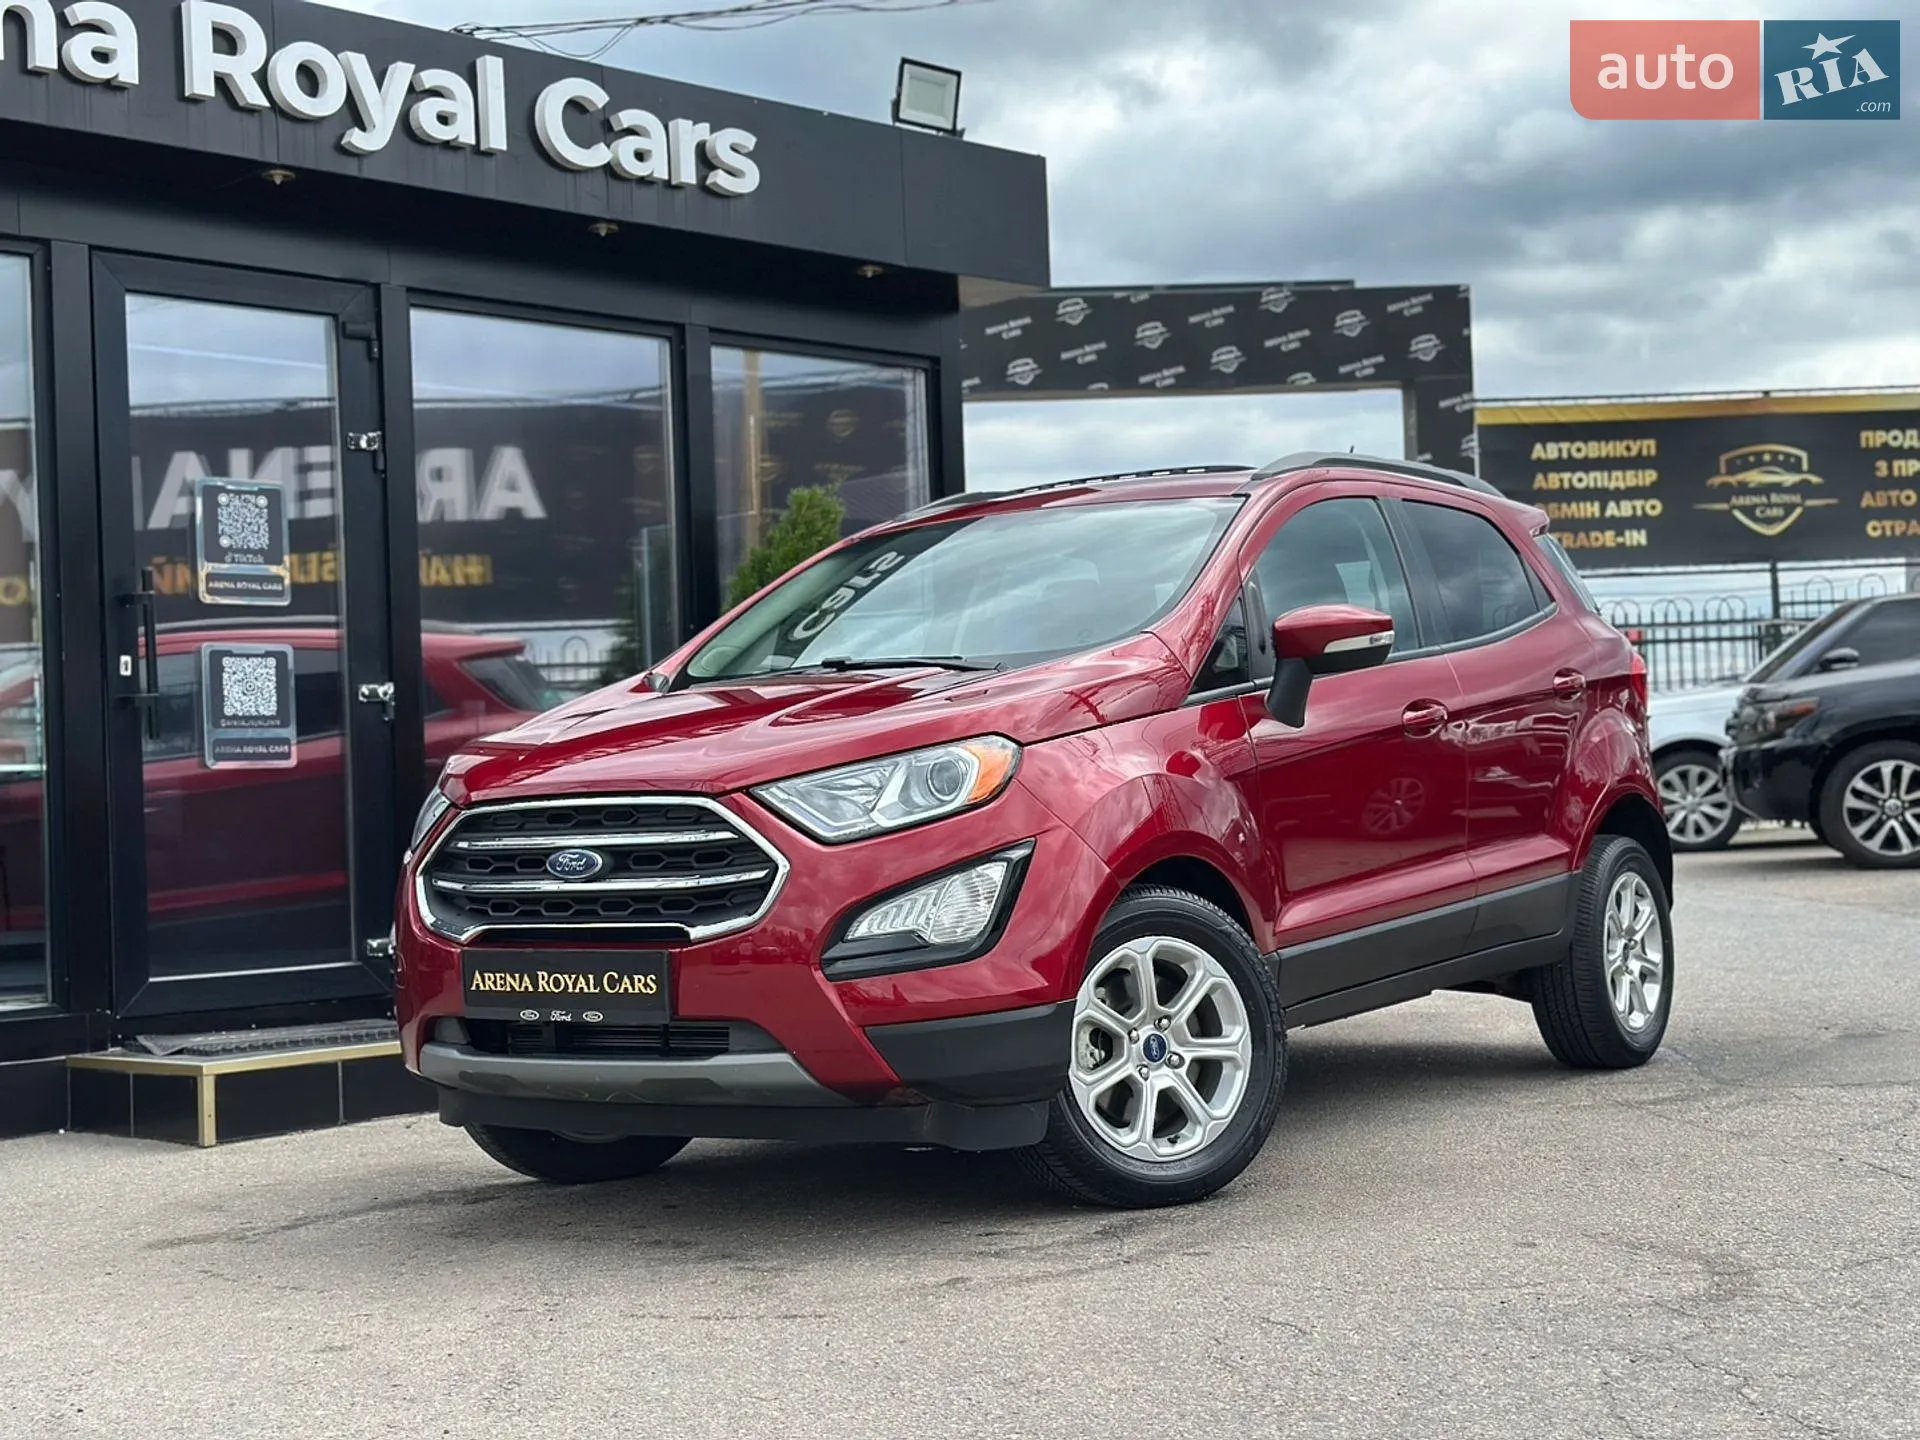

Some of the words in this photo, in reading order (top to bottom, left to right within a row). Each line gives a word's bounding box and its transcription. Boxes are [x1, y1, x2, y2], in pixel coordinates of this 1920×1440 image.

[181, 0, 507, 154] Royal
[535, 77, 760, 197] Cars
[1531, 438, 1657, 460] АВТОВИКУП
[1533, 469, 1658, 490] АВТОПІДБІР
[1605, 499, 1662, 517] АВТО
[1860, 489, 1917, 508] АВТО
[556, 854, 586, 871] Ford
[470, 970, 533, 992] ARENA
[537, 971, 600, 993] ROYAL
[603, 972, 657, 994] CARS
[550, 1010, 572, 1022] Ford
